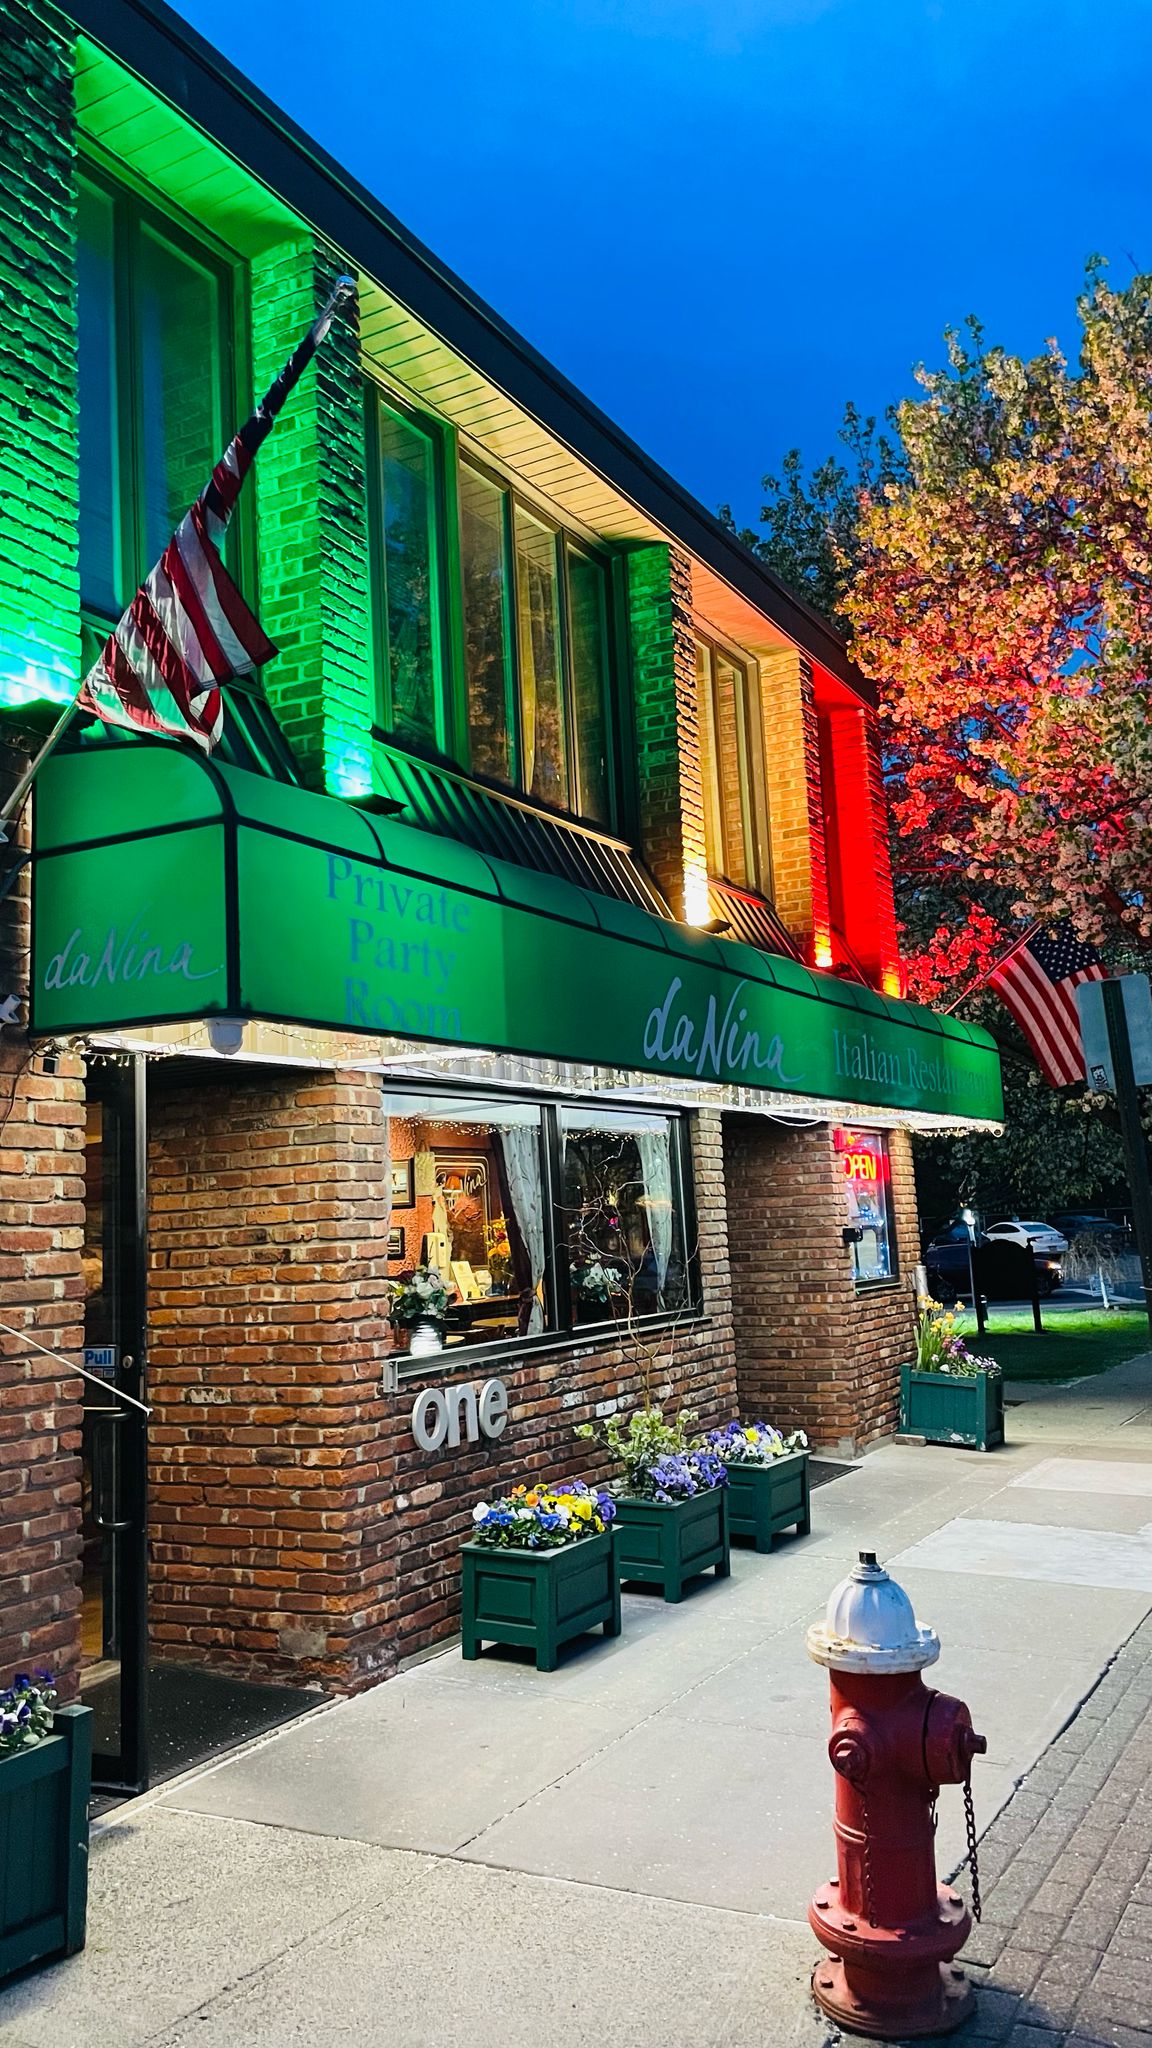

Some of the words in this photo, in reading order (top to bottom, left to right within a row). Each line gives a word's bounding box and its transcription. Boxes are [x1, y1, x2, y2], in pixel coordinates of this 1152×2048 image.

[326, 853, 470, 934] Private
[44, 906, 224, 990] daNina
[349, 917, 456, 993] Party
[344, 976, 462, 1040] Room
[643, 976, 805, 1083] daNina
[832, 1028, 902, 1085] Italian
[842, 1153, 877, 1180] OPEN
[85, 1350, 112, 1364] Pull
[412, 1378, 508, 1451] one
